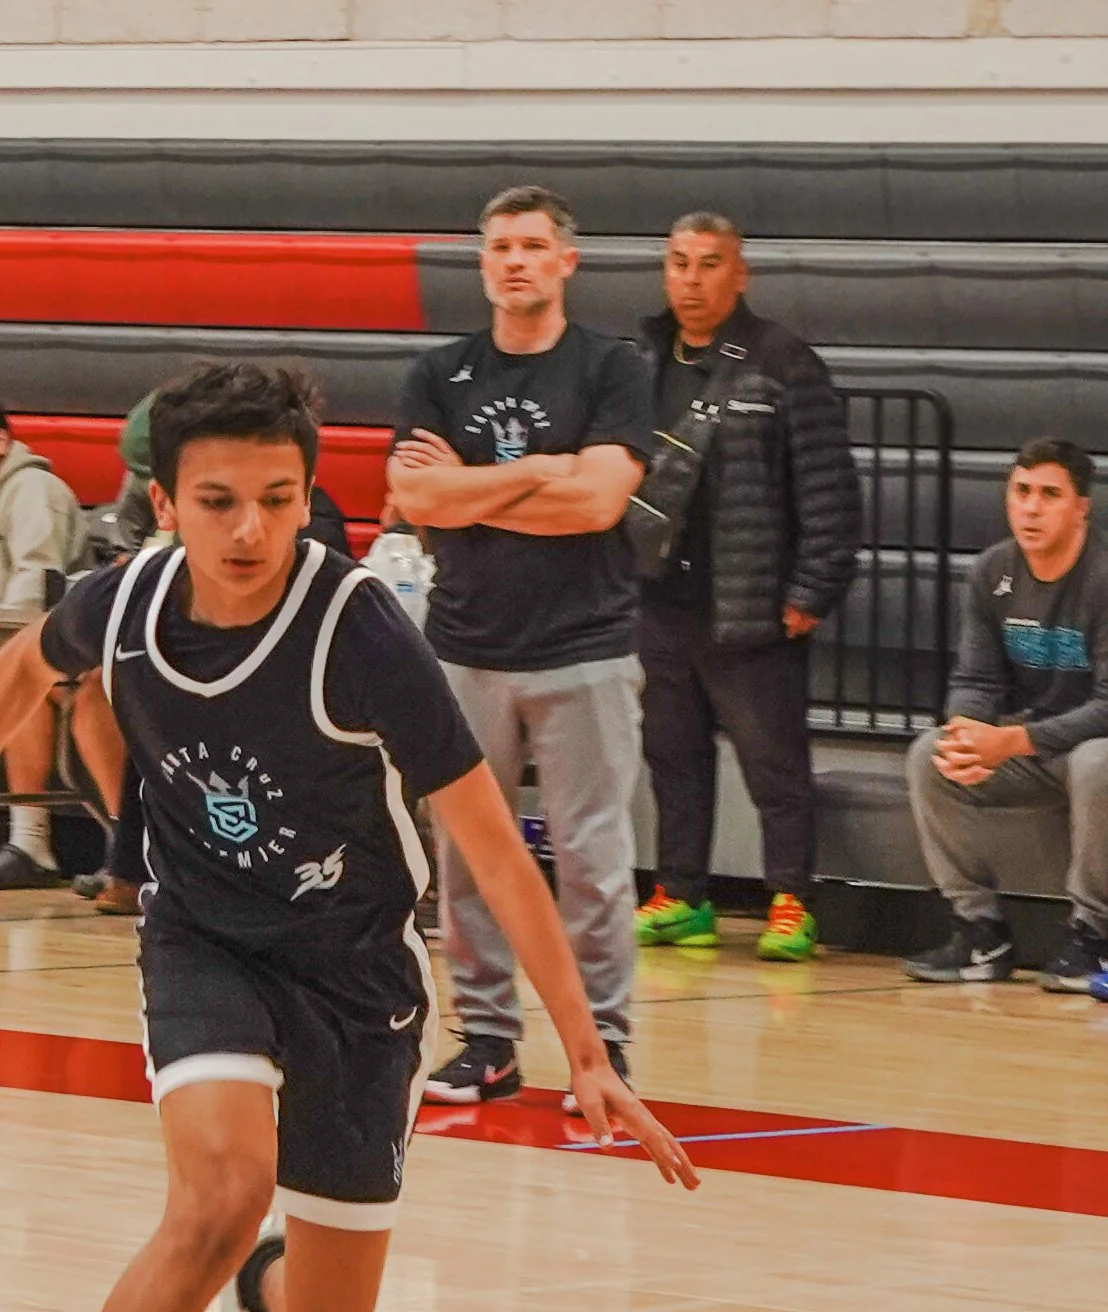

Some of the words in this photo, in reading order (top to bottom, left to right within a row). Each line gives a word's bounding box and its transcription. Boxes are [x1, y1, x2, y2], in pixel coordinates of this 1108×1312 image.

[230, 745, 284, 800] CRUZ
[189, 826, 297, 869] MIER
[290, 842, 347, 902] 35
